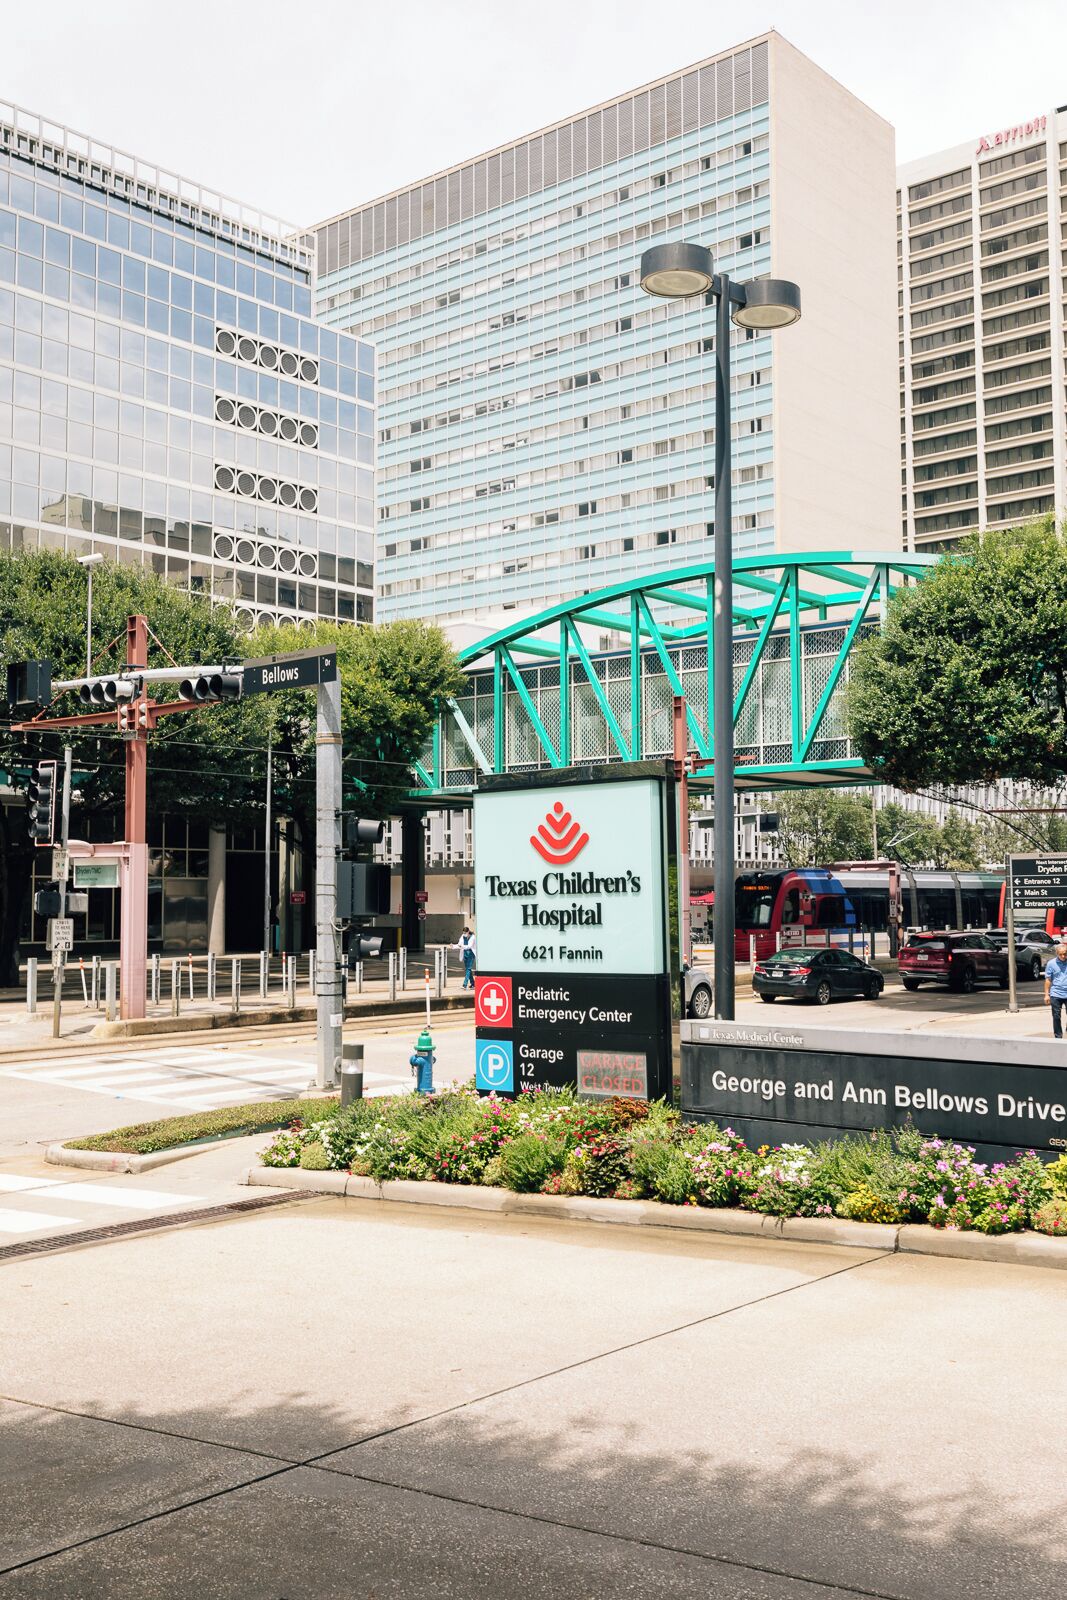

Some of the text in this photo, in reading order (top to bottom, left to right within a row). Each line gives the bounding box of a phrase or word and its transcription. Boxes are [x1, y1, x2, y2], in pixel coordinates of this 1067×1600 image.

[262, 666, 299, 684] Bellows
[1038, 865, 1062, 874] Dryden
[485, 870, 641, 896] Texas Children's
[521, 903, 603, 932] Hospital
[522, 946, 603, 960] 6621 Fannin
[518, 986, 570, 1001] Pediatric
[518, 1004, 632, 1024] Emergency Center
[712, 1030, 804, 1044] Texas Medical Center
[519, 1044, 564, 1063] Garage
[580, 1052, 644, 1070] GARAGE
[488, 1054, 504, 1078] P
[519, 1063, 535, 1076] 12
[520, 1080, 566, 1093] West Tow
[582, 1075, 643, 1093] CLOSED
[712, 1070, 1066, 1122] George and Ann Bellows Drive
[1049, 1138, 1067, 1147] GEO
